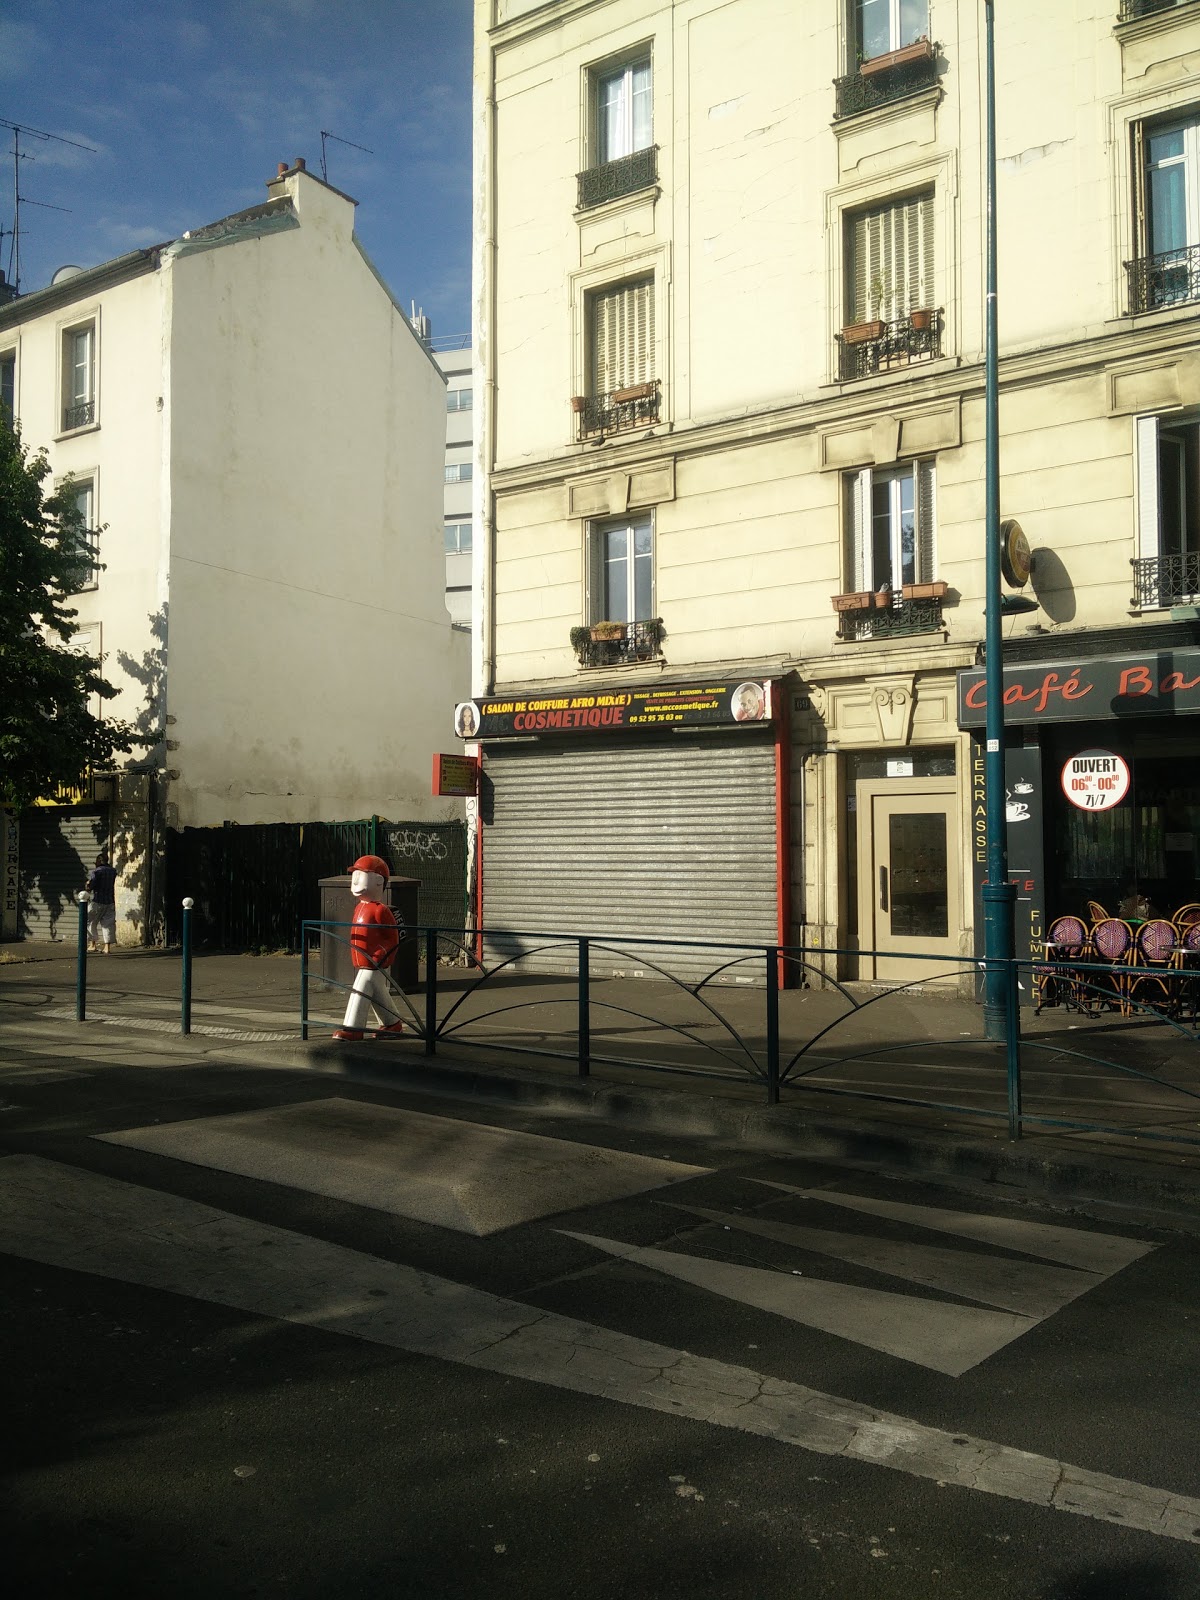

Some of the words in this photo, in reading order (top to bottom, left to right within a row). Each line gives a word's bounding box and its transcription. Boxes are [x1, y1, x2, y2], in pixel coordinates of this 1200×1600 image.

[487, 702, 514, 714] SALON
[515, 702, 527, 712] DE
[528, 699, 571, 711] COIFFURE
[571, 697, 595, 708] AFRO
[596, 694, 626, 707] MIXTE
[644, 701, 719, 712] www.mccosmetique.fr
[513, 707, 624, 730] COSMETIQUE
[629, 715, 638, 723] 09
[647, 714, 656, 722] 95
[1072, 758, 1118, 773] OUVERT
[974, 744, 987, 864] TERRASSE
[1085, 794, 1106, 807] 7j/7
